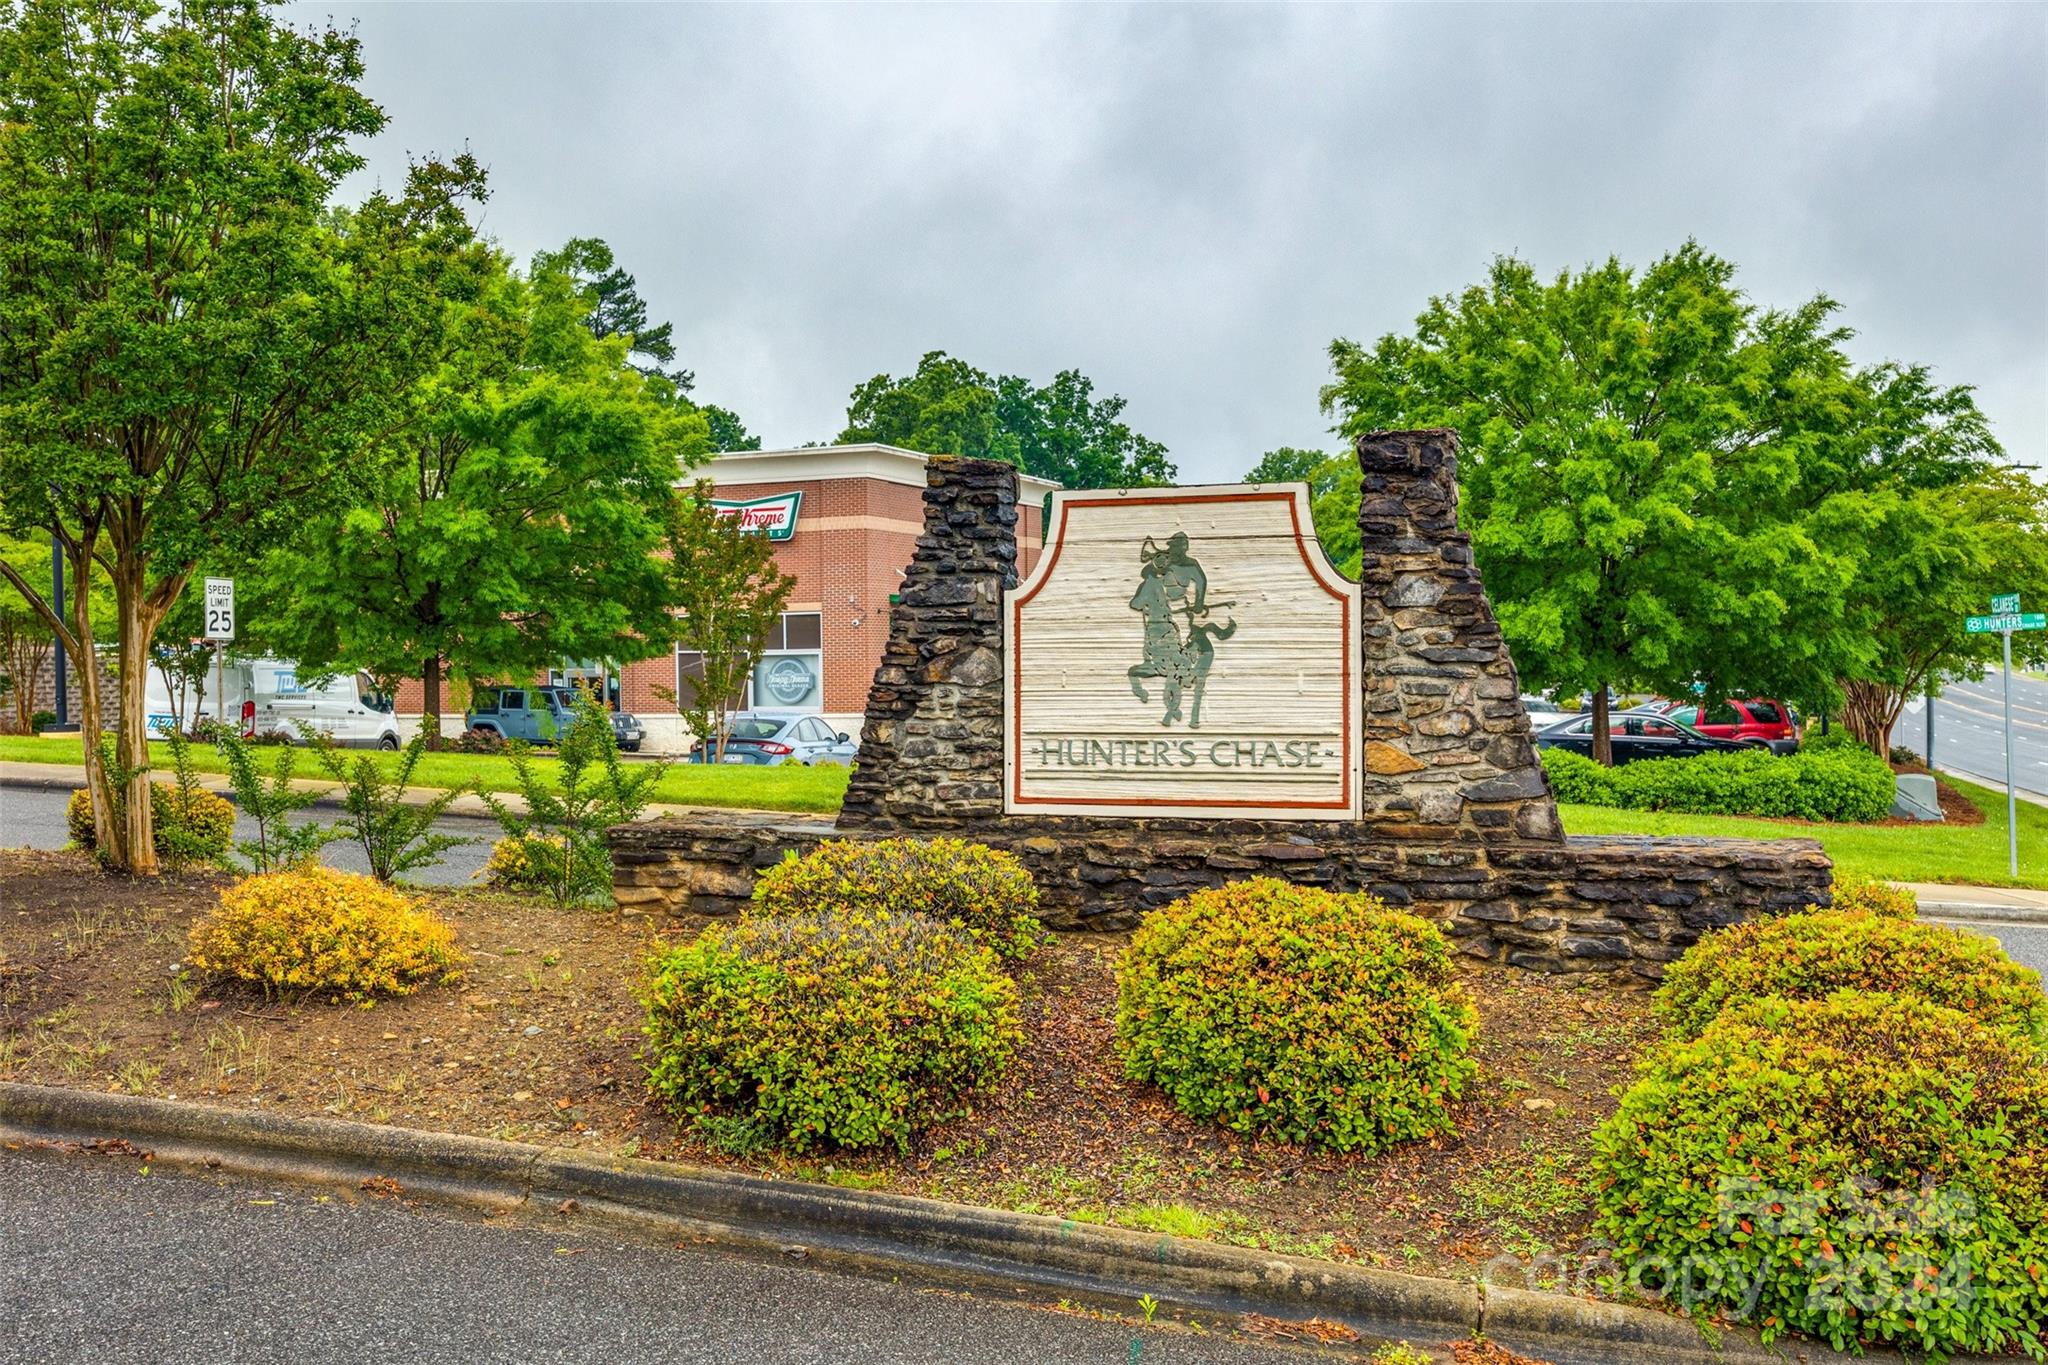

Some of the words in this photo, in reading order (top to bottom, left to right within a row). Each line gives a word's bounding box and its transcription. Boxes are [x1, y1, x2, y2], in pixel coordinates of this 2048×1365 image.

[208, 584, 231, 595] SPEED
[210, 597, 229, 607] LIMIT
[208, 609, 231, 632] 25
[1984, 616, 2022, 629] HUNTERS
[1041, 738, 1197, 767] HUNTER'S
[1209, 740, 1323, 768] CHASE
